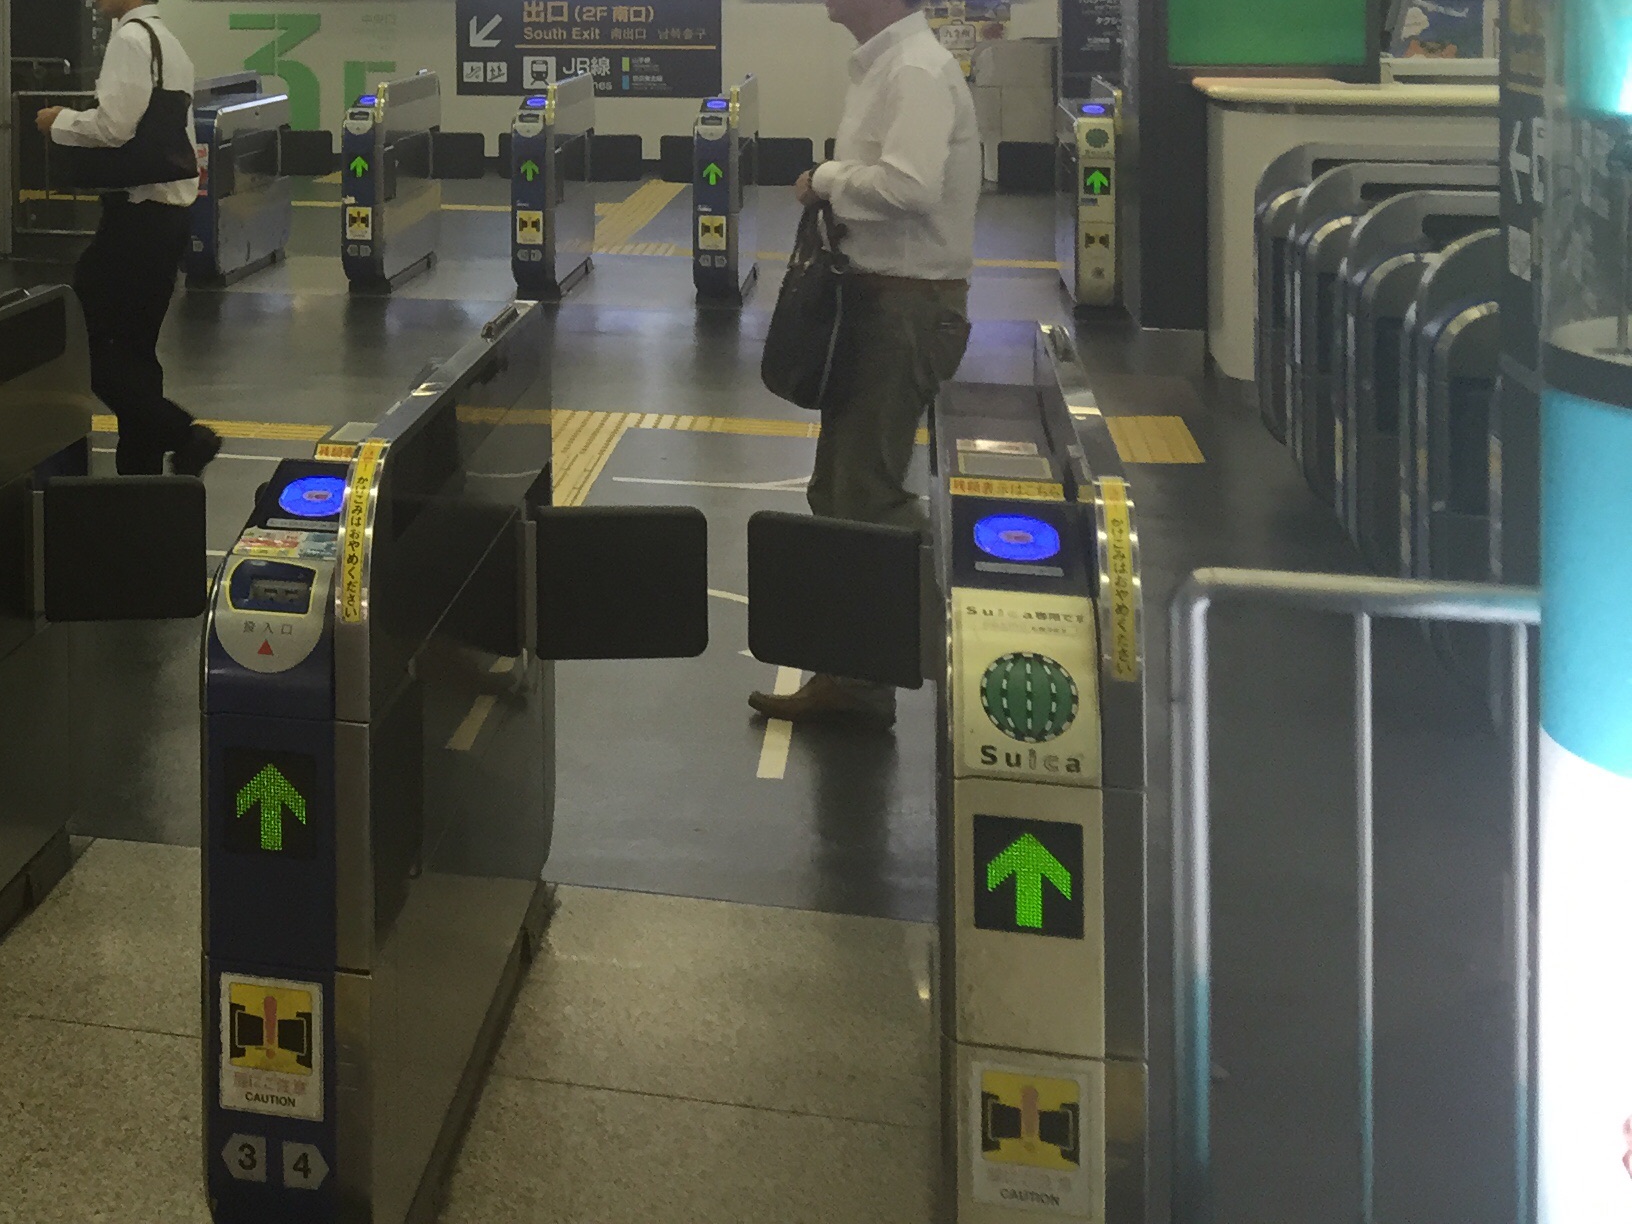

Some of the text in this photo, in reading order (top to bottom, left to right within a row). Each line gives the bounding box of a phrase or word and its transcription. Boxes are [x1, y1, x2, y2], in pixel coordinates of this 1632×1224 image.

[523, 0, 569, 23] 出口
[523, 27, 567, 41] South
[572, 27, 600, 40] Exit
[563, 57, 611, 76] JR線
[344, 476, 368, 618] かけこみはおやめください
[980, 744, 1082, 774] Suica
[245, 1091, 297, 1108] CAUTION
[237, 1142, 312, 1179] 3 4
[1000, 1188, 1061, 1207] CAUTION
